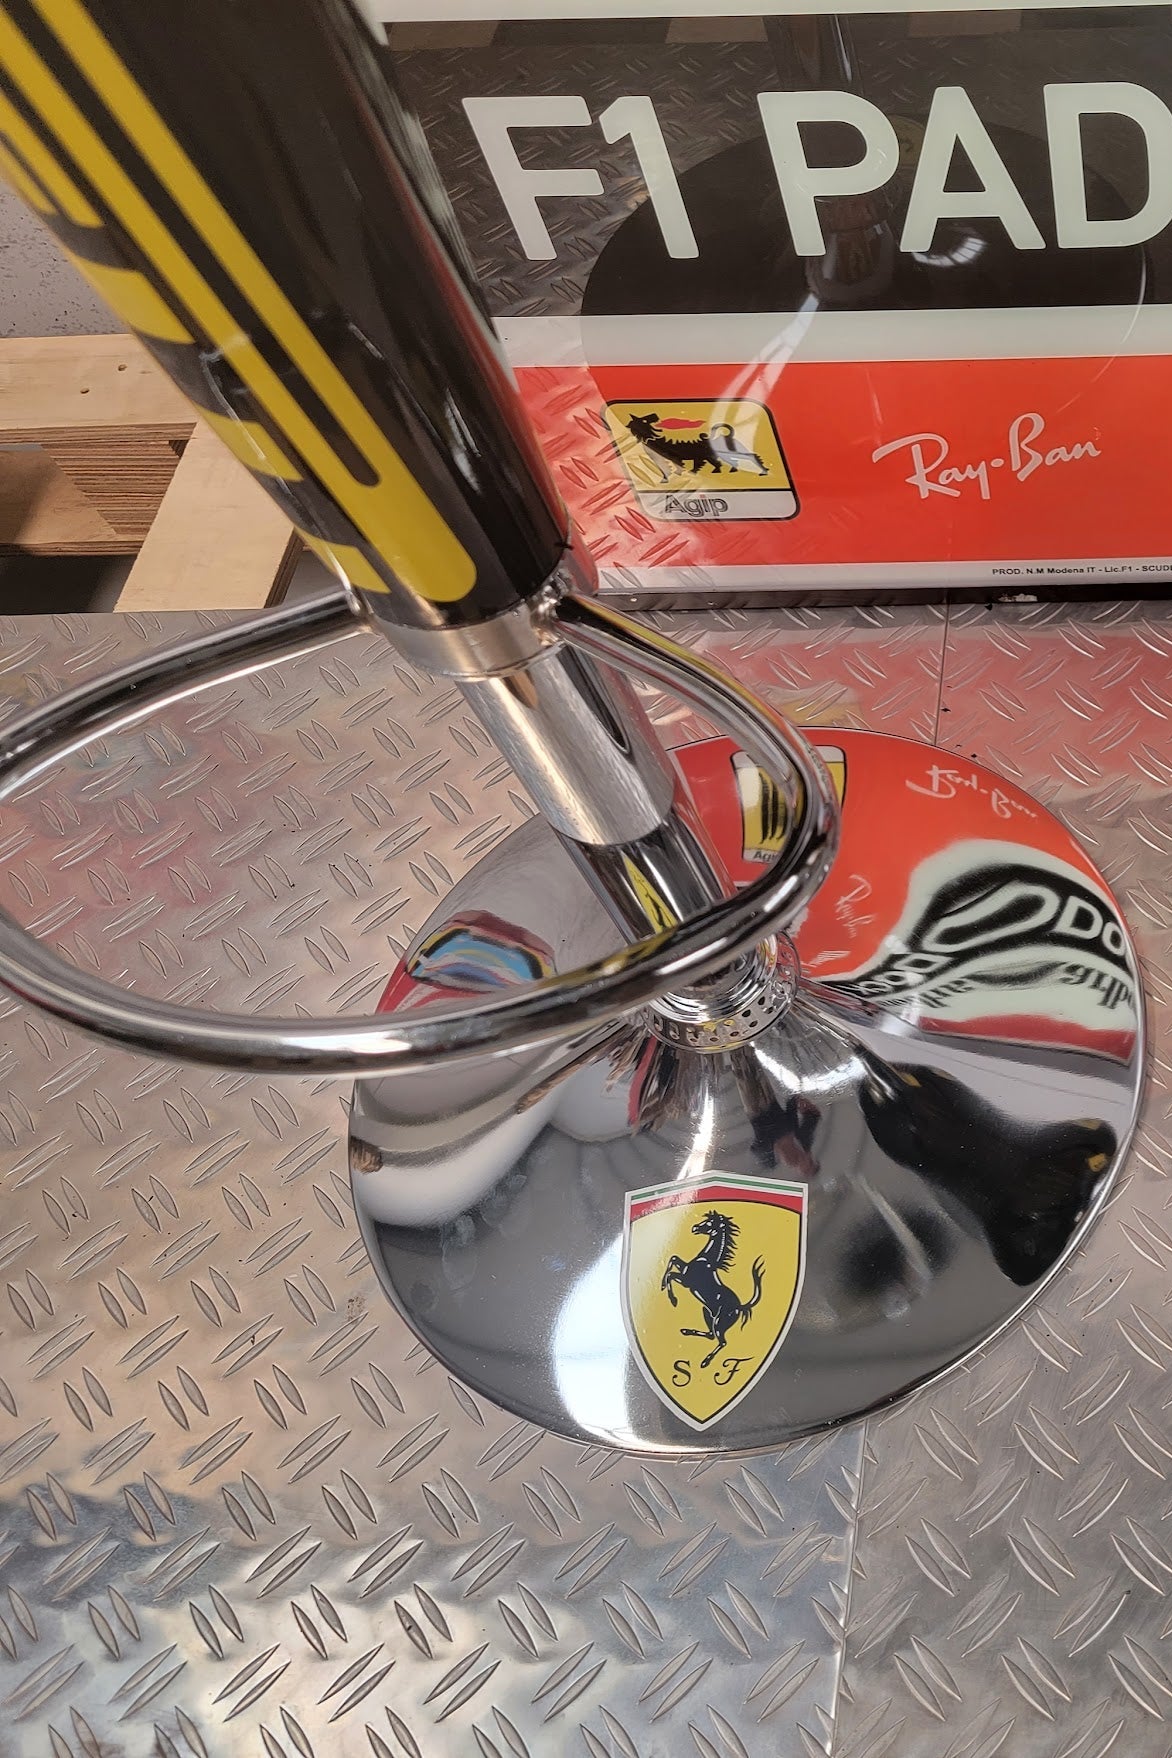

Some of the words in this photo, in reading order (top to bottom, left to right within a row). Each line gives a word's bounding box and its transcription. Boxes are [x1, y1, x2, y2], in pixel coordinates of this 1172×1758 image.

[461, 96, 699, 260] F1
[665, 494, 729, 517] Agip
[992, 568, 1024, 576] PROD.
[1047, 566, 1084, 574] Modena
[671, 1359, 692, 1388] S
